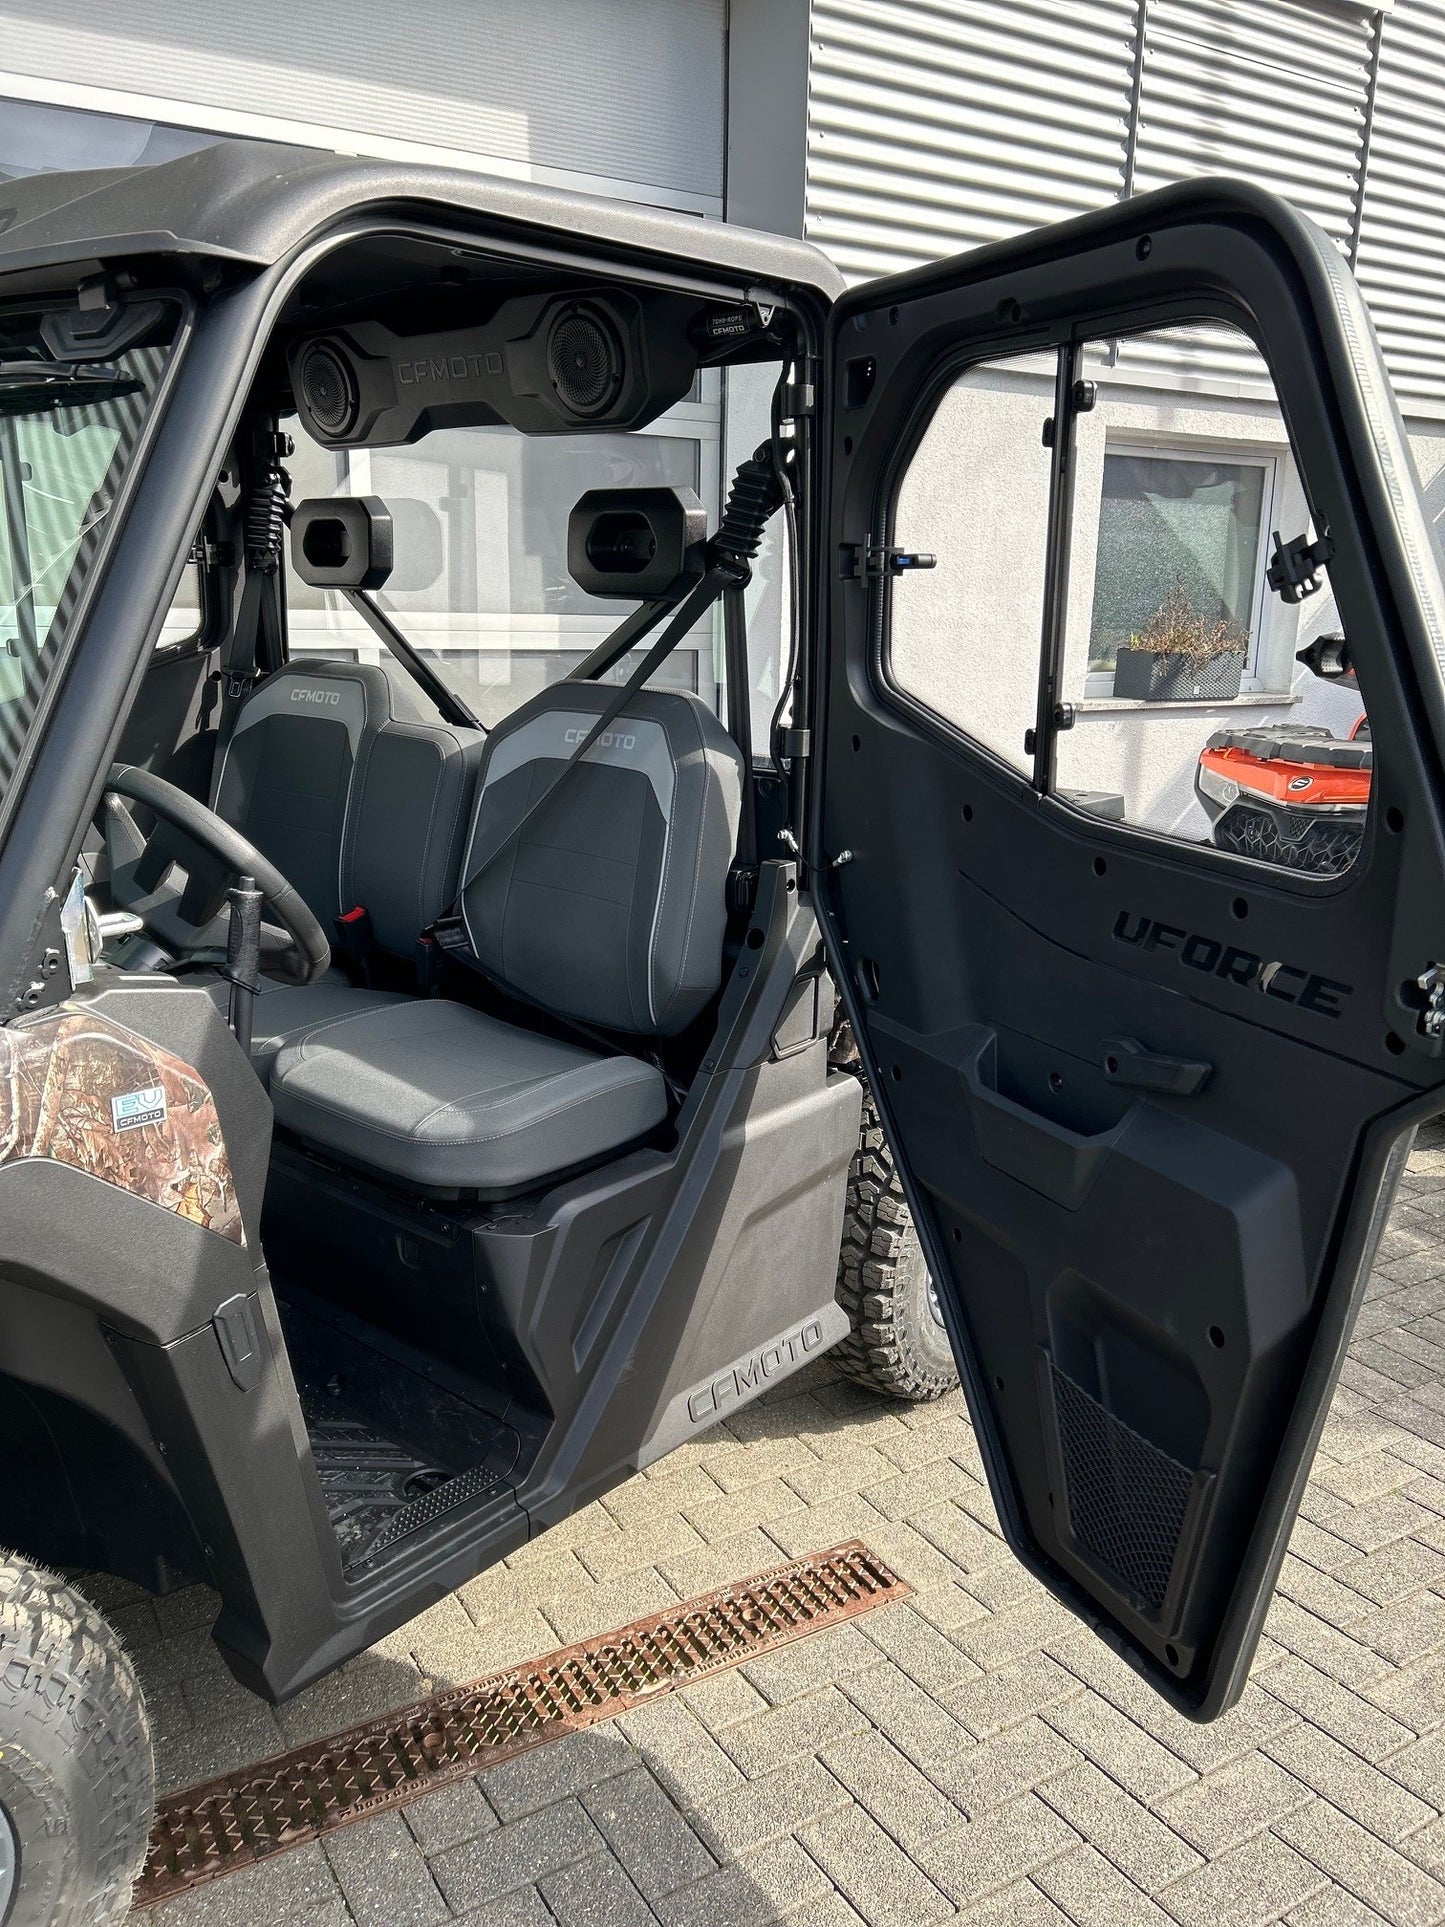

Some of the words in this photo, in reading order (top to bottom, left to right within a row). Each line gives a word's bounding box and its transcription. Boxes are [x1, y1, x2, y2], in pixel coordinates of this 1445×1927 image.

[713, 325, 745, 335] CFMOTO
[398, 353, 504, 384] CFMOTO
[290, 689, 341, 705] CFMOTO
[564, 729, 636, 750] CFOTO
[1112, 910, 1354, 1019] UFORCE
[115, 1089, 163, 1117] EV
[120, 1110, 161, 1127] CFMOTO
[687, 1319, 823, 1423] CFMOTO
[353, 1778, 429, 1812] hauraton
